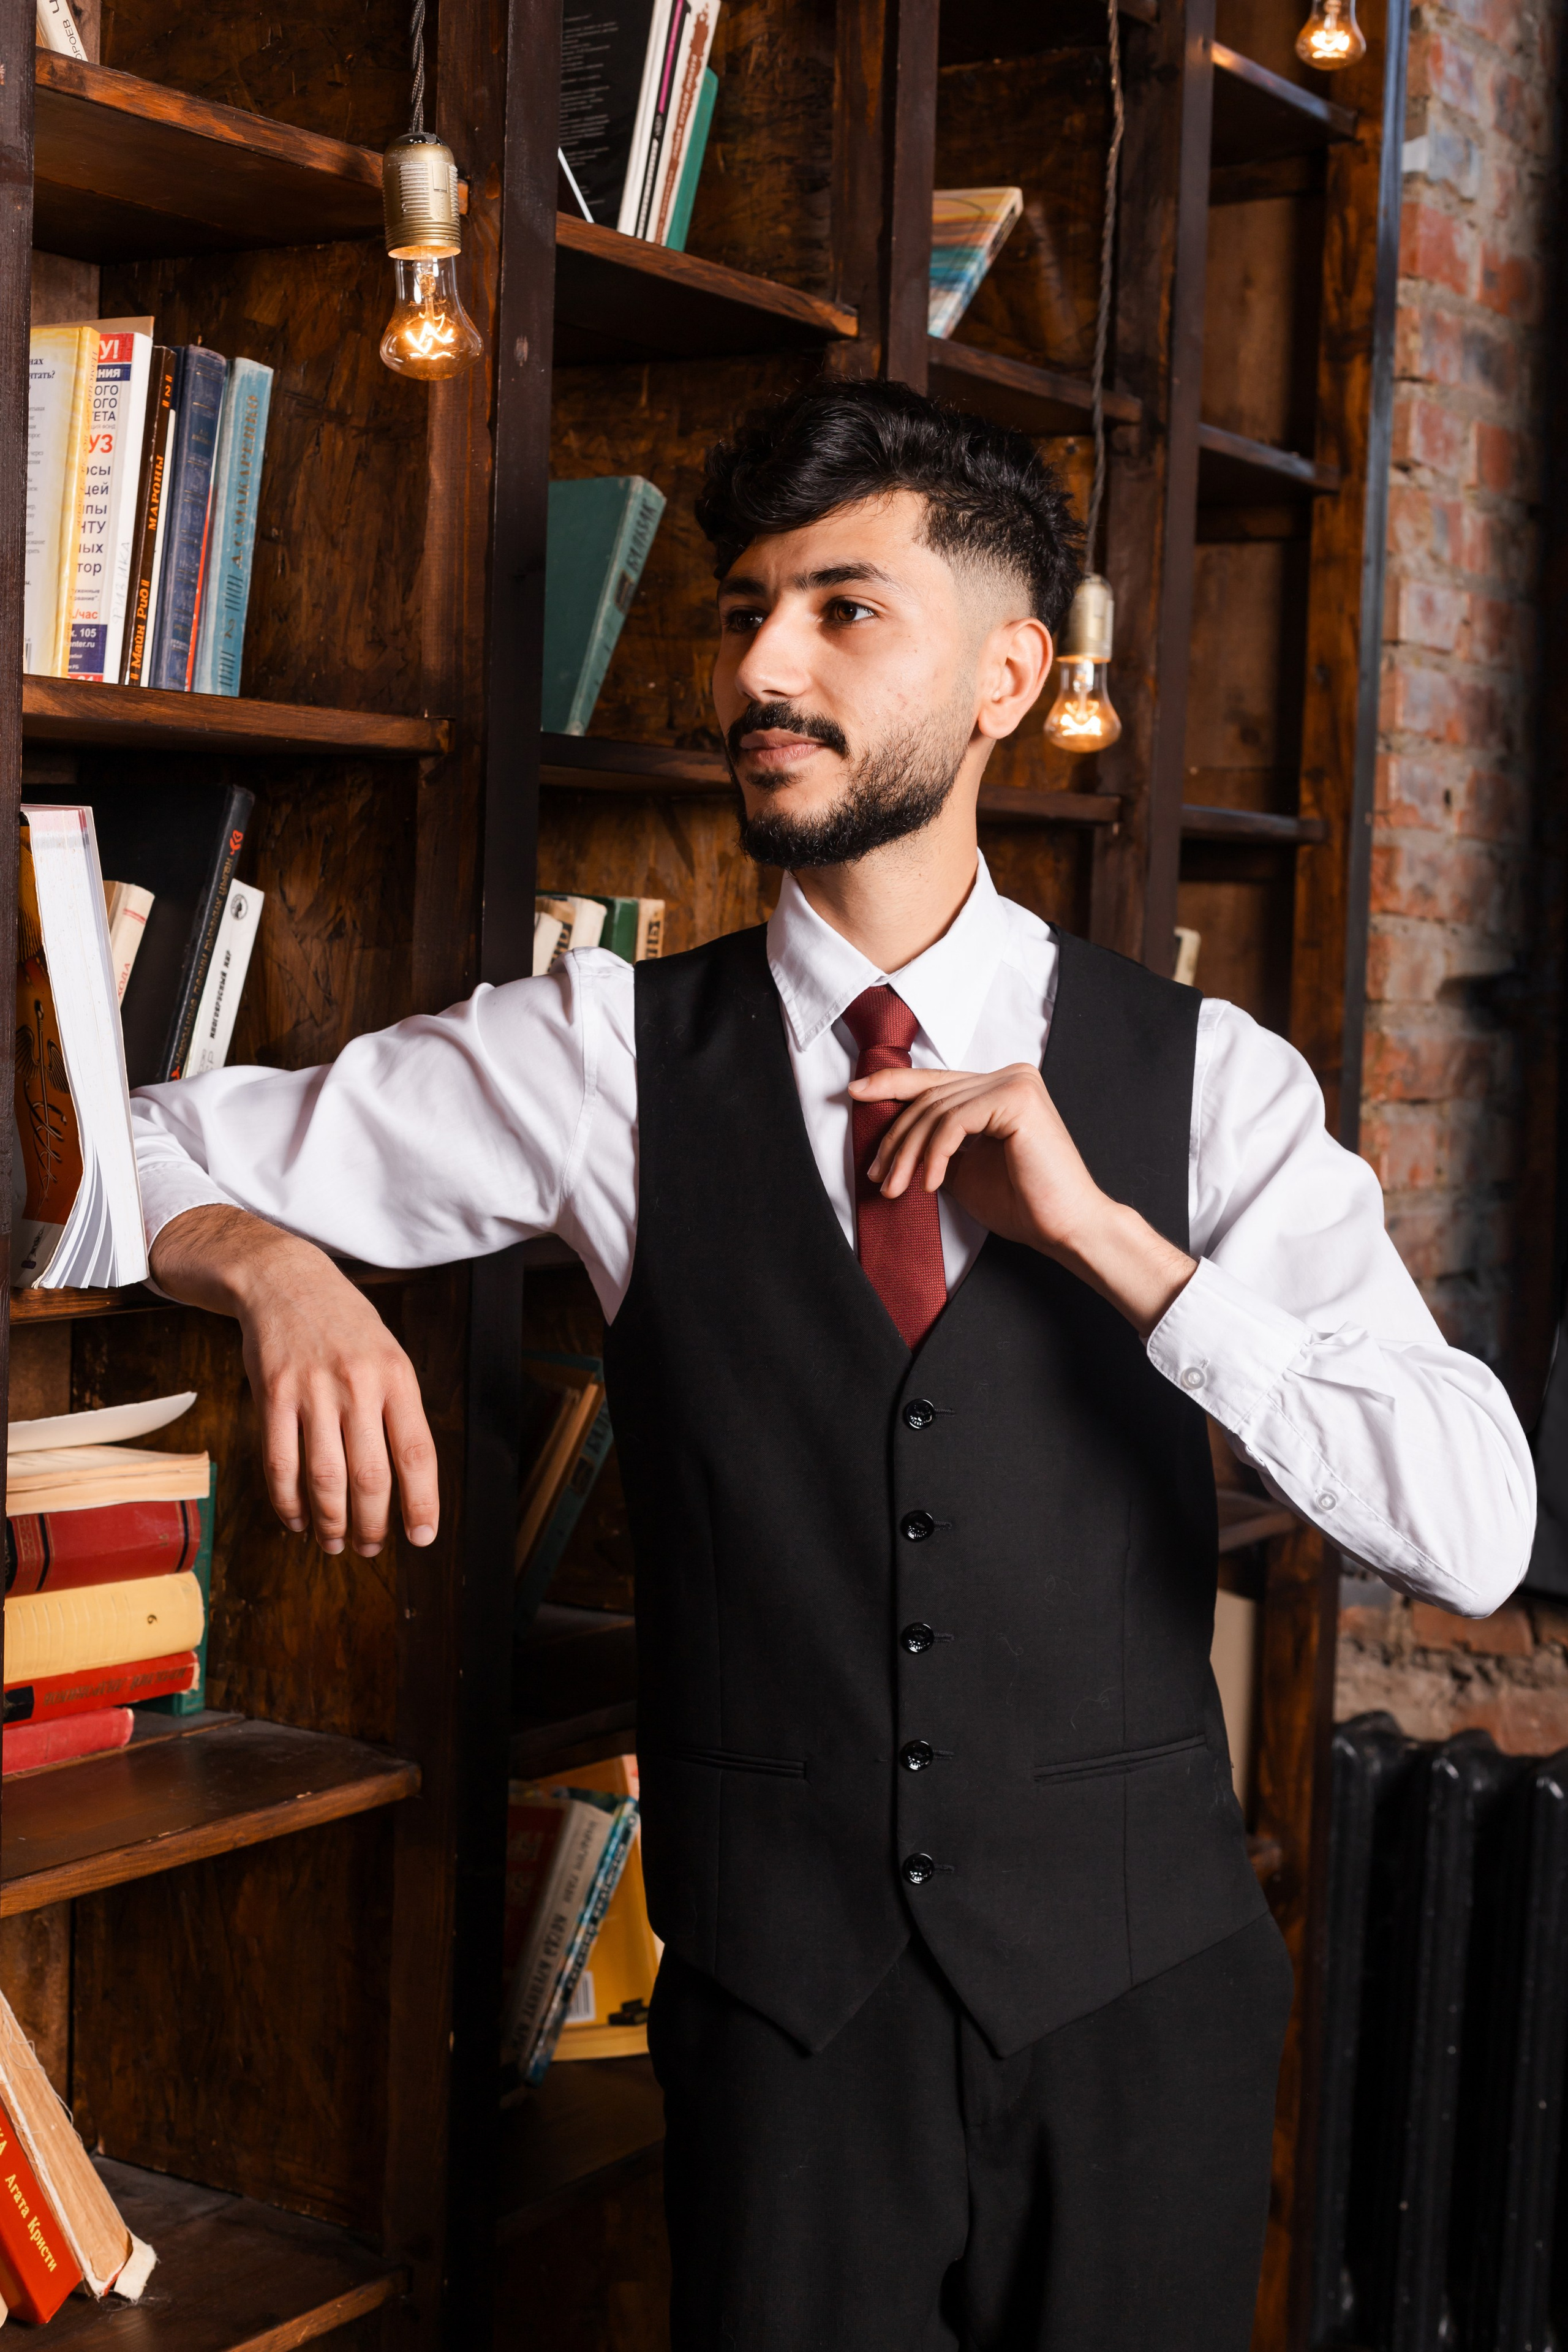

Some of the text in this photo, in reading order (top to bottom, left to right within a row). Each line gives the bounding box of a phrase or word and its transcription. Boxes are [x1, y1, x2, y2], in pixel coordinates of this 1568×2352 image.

[97, 368, 121, 379] НИЯ
[94, 385, 119, 396] ОГО
[164, 385, 172, 398] 2
[93, 398, 118, 409] ОГО
[92, 410, 116, 421] ЕТА
[148, 454, 164, 531] МАРОНЫ
[80, 628, 97, 638] 105
[130, 587, 149, 669] Майн Рид
[224, 618, 236, 639] 2
[192, 951, 208, 996] песни
[218, 857, 233, 895] цыган
[223, 949, 233, 970] МИР
[5, 2174, 58, 2273] Агата Кристи
